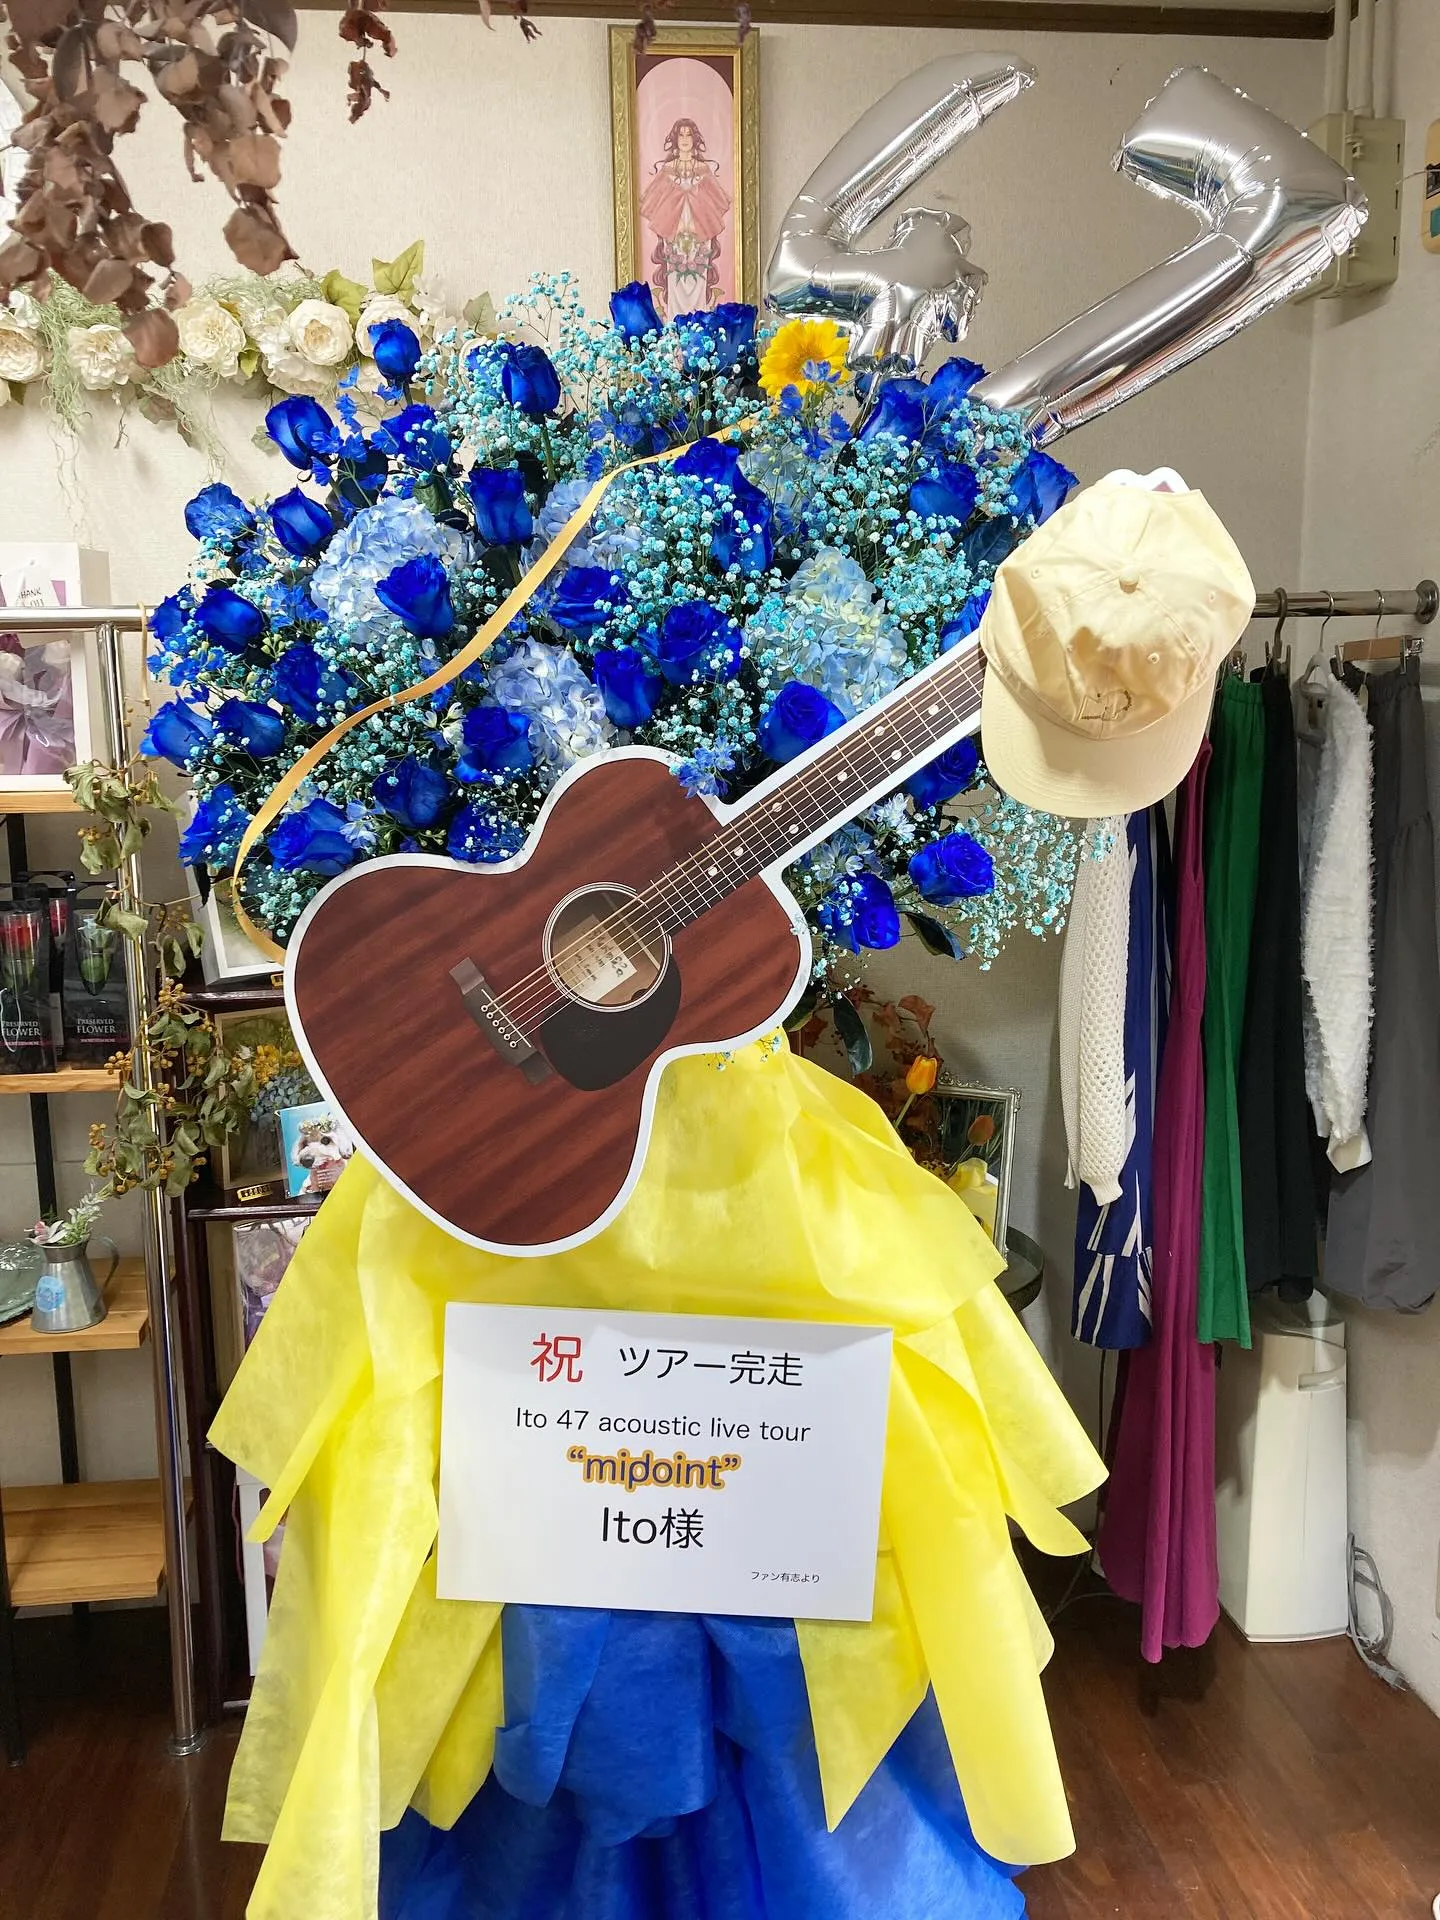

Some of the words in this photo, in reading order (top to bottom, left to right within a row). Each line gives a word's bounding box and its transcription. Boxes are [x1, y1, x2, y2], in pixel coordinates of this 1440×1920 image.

[18, 588, 42, 599] HANK
[2, 1028, 41, 1037] FLOWER
[77, 1025, 116, 1034] FLOWER
[530, 1332, 584, 1383] 祝
[619, 1346, 804, 1387] ツアー完走
[516, 1407, 547, 1428] Ito
[556, 1409, 590, 1430] 47
[599, 1416, 701, 1436] acoustic
[710, 1417, 750, 1440] live
[760, 1421, 811, 1442] tour
[602, 1506, 705, 1549] Ito様
[751, 1570, 821, 1584] ファン有志より
